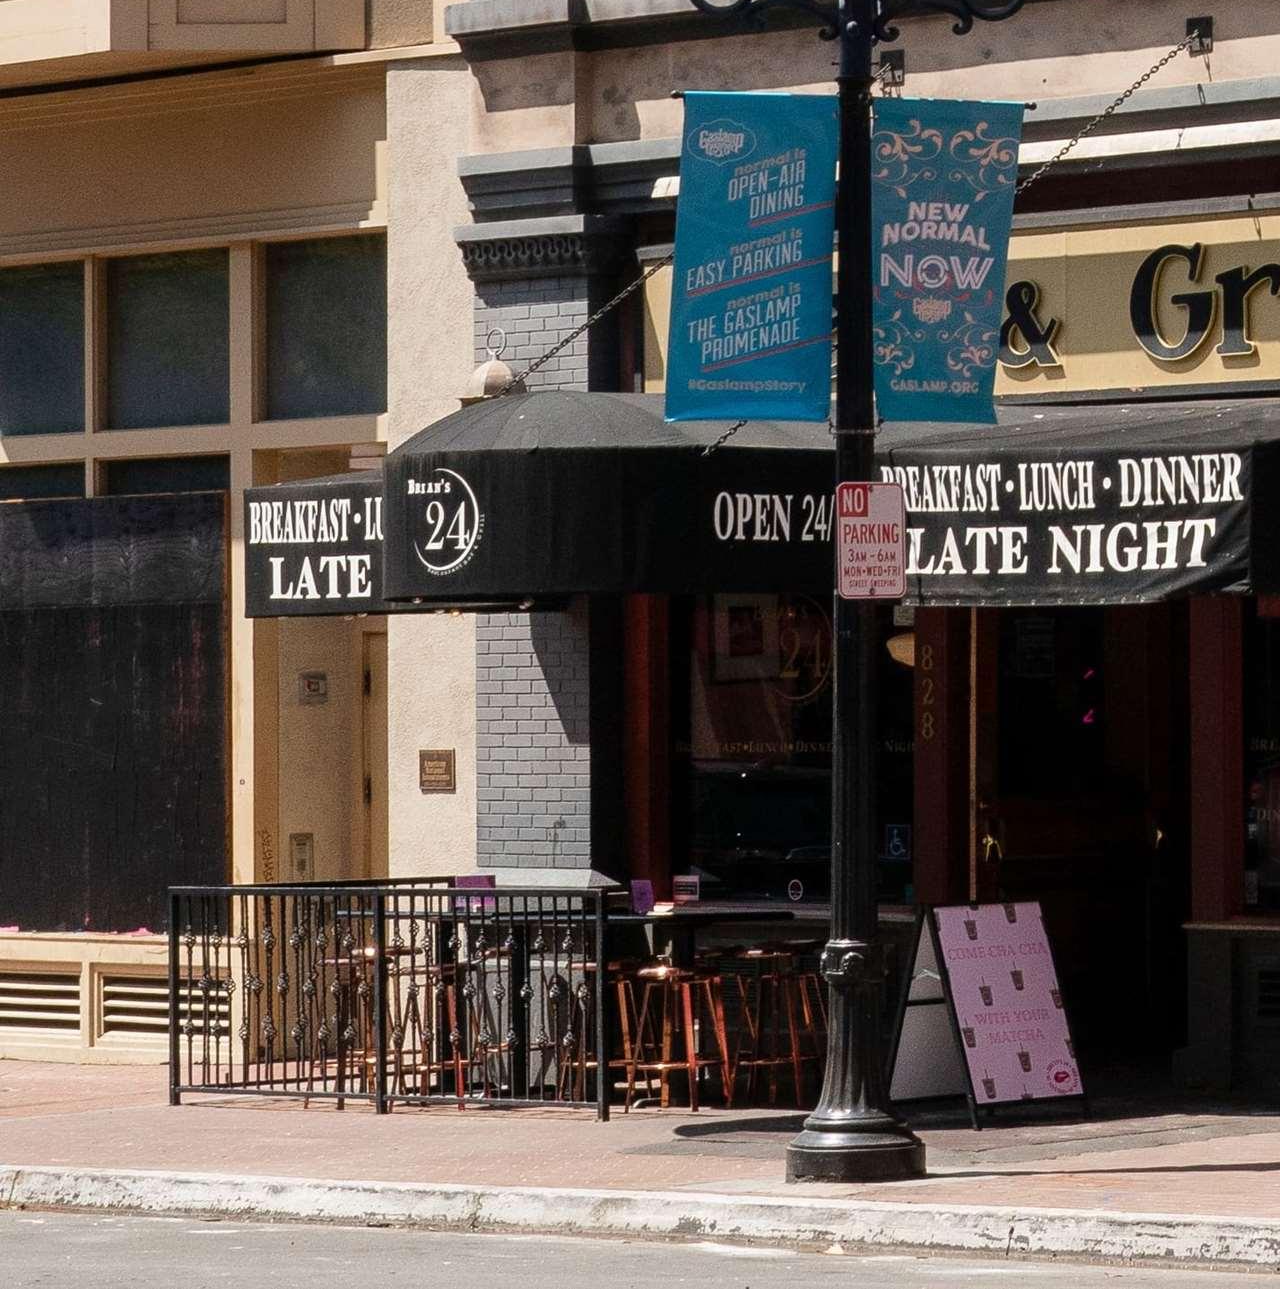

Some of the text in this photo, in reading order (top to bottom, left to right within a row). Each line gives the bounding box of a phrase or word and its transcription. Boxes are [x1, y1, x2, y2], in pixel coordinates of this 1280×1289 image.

[728, 159, 806, 202] OPEN-AIR
[750, 184, 805, 219] DINING
[908, 201, 970, 223] NEW
[882, 221, 991, 251] NORMAL
[686, 239, 803, 292] EASY PARKING
[880, 253, 995, 290] NOW
[687, 293, 802, 344] THE GASLAMP
[702, 317, 802, 364] PROMENADE
[889, 379, 980, 395] GASLAMP.ORG
[842, 488, 864, 513] NO
[1018, 460, 1096, 511] LUNCH
[1118, 452, 1244, 509] DINNER
[249, 498, 351, 545] BREAKFAST
[424, 500, 471, 550] 24
[713, 490, 836, 542] OPEN 24/
[843, 523, 900, 545] PARKING
[848, 548, 867, 563] 3AM
[877, 548, 896, 563] 6AM
[905, 517, 1217, 576] LATE NIGHT
[268, 554, 372, 600] LATE
